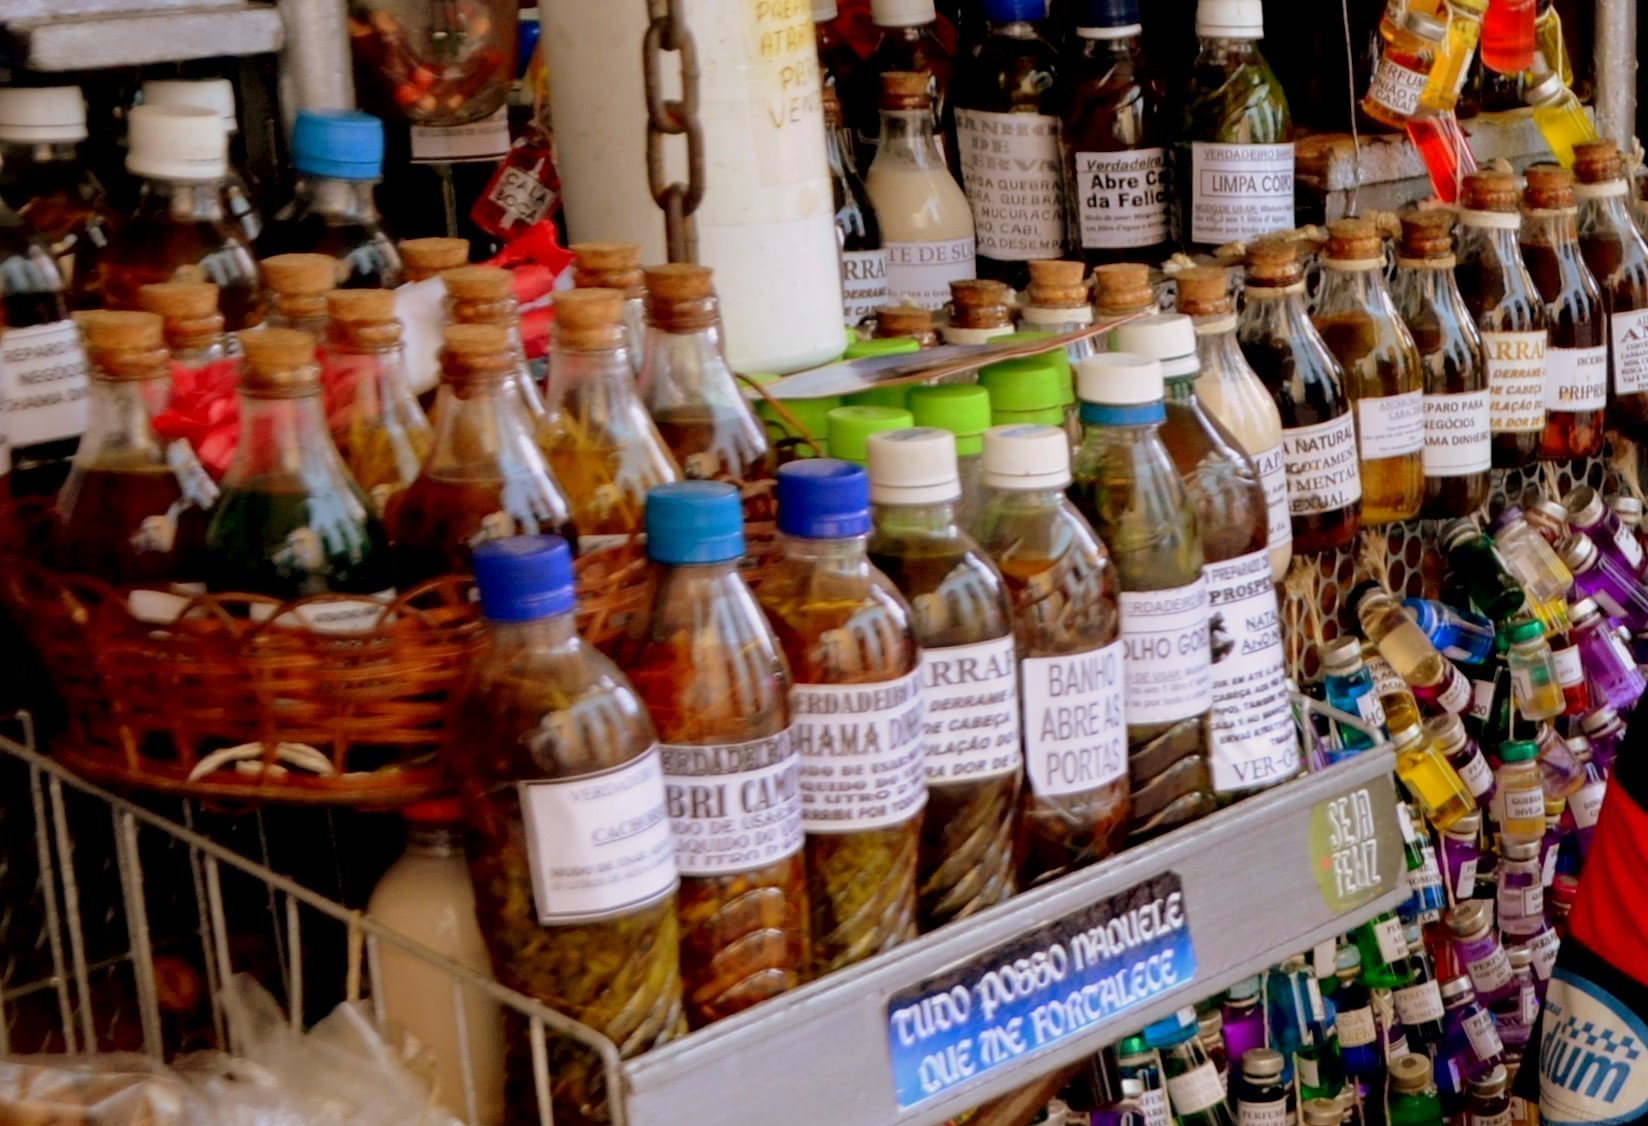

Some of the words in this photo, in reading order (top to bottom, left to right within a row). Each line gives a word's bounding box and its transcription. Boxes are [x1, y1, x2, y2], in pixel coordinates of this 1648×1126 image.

[1374, 90, 1413, 113] CASAL
[1091, 174, 1140, 191] Abre
[1211, 175, 1258, 193] LIMPA
[1086, 195, 1110, 210] da
[918, 245, 950, 263] DE
[1295, 426, 1354, 454] NATURAL
[1296, 465, 1358, 492] MENTAL
[1048, 652, 1116, 698] BANHO
[929, 689, 1007, 713] DERRAME
[1039, 700, 1100, 742] ABRE
[1104, 693, 1121, 730] AS
[952, 759, 987, 777] DOR
[1046, 738, 1121, 787] PORTAS
[1514, 805, 1542, 817] INVEJA
[889, 984, 972, 1047] TUDO
[974, 943, 1068, 1022] POSSO
[1069, 890, 1185, 973] NAQUELE
[918, 1037, 978, 1094] QUE
[978, 1016, 1027, 1066] ME
[1030, 948, 1179, 1045] FORTALECE
